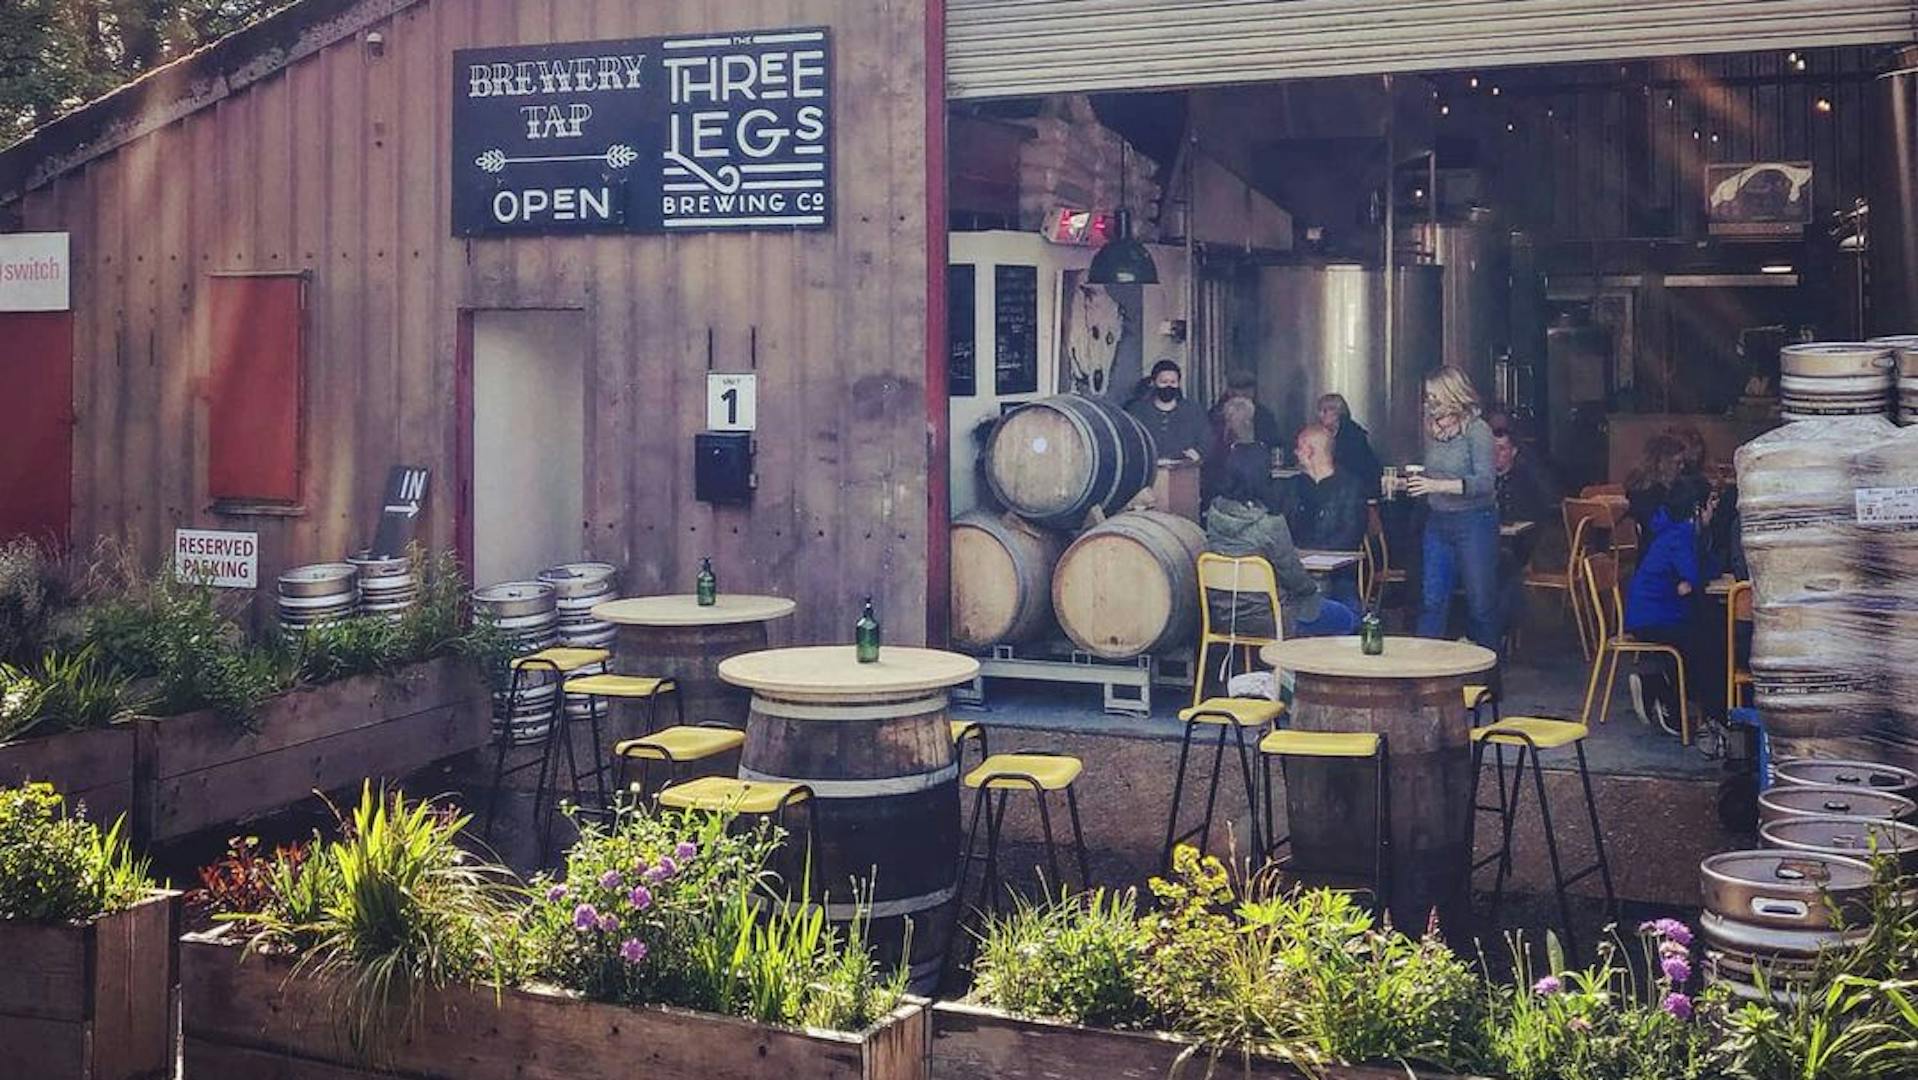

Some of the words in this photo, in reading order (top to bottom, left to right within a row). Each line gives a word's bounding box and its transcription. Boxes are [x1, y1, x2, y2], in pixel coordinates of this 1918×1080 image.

[468, 54, 646, 97] BREWERY
[663, 50, 824, 102] THREE
[520, 103, 592, 139] TAP
[663, 105, 824, 192] LEGS
[493, 187, 609, 223] OPEN
[663, 193, 786, 214] BREWING
[0, 256, 60, 281] switch
[721, 389, 737, 424] 1
[400, 470, 427, 500] IN
[179, 537, 254, 557] RESERVED
